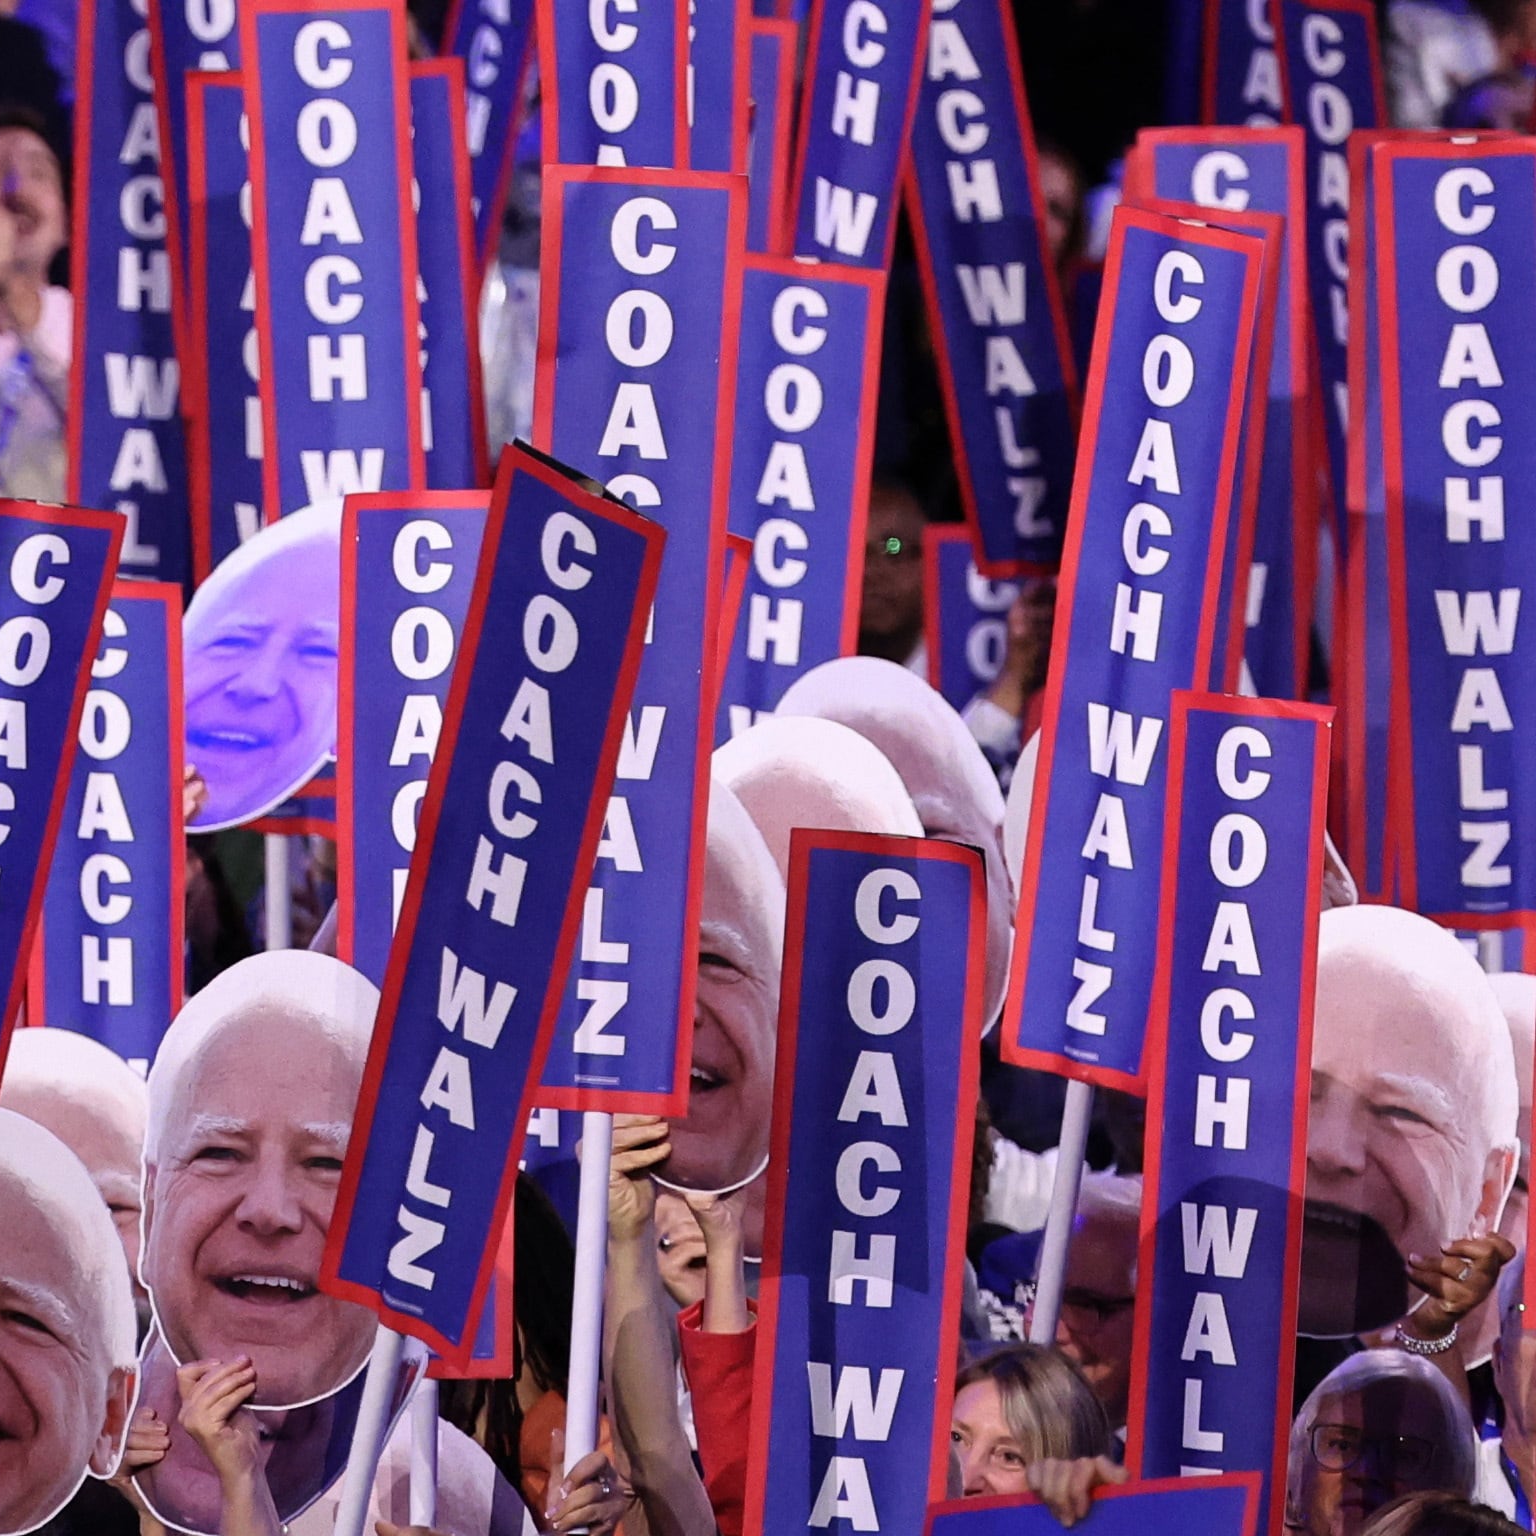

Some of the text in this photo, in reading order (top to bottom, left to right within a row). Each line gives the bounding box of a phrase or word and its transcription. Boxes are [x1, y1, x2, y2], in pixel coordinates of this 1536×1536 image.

[293, 19, 368, 402] COACH
[928, 0, 1003, 223] ACH
[104, 353, 180, 582] WAL
[747, 286, 828, 667] COACH
[957, 261, 1055, 538] WALZ
[1434, 166, 1522, 888] COACH WALZ
[1065, 249, 1204, 1037] COACH WALZ
[387, 511, 597, 1292] COACH WALZ
[828, 868, 922, 1309] COACH
[1179, 725, 1272, 1475] COACH WAL
